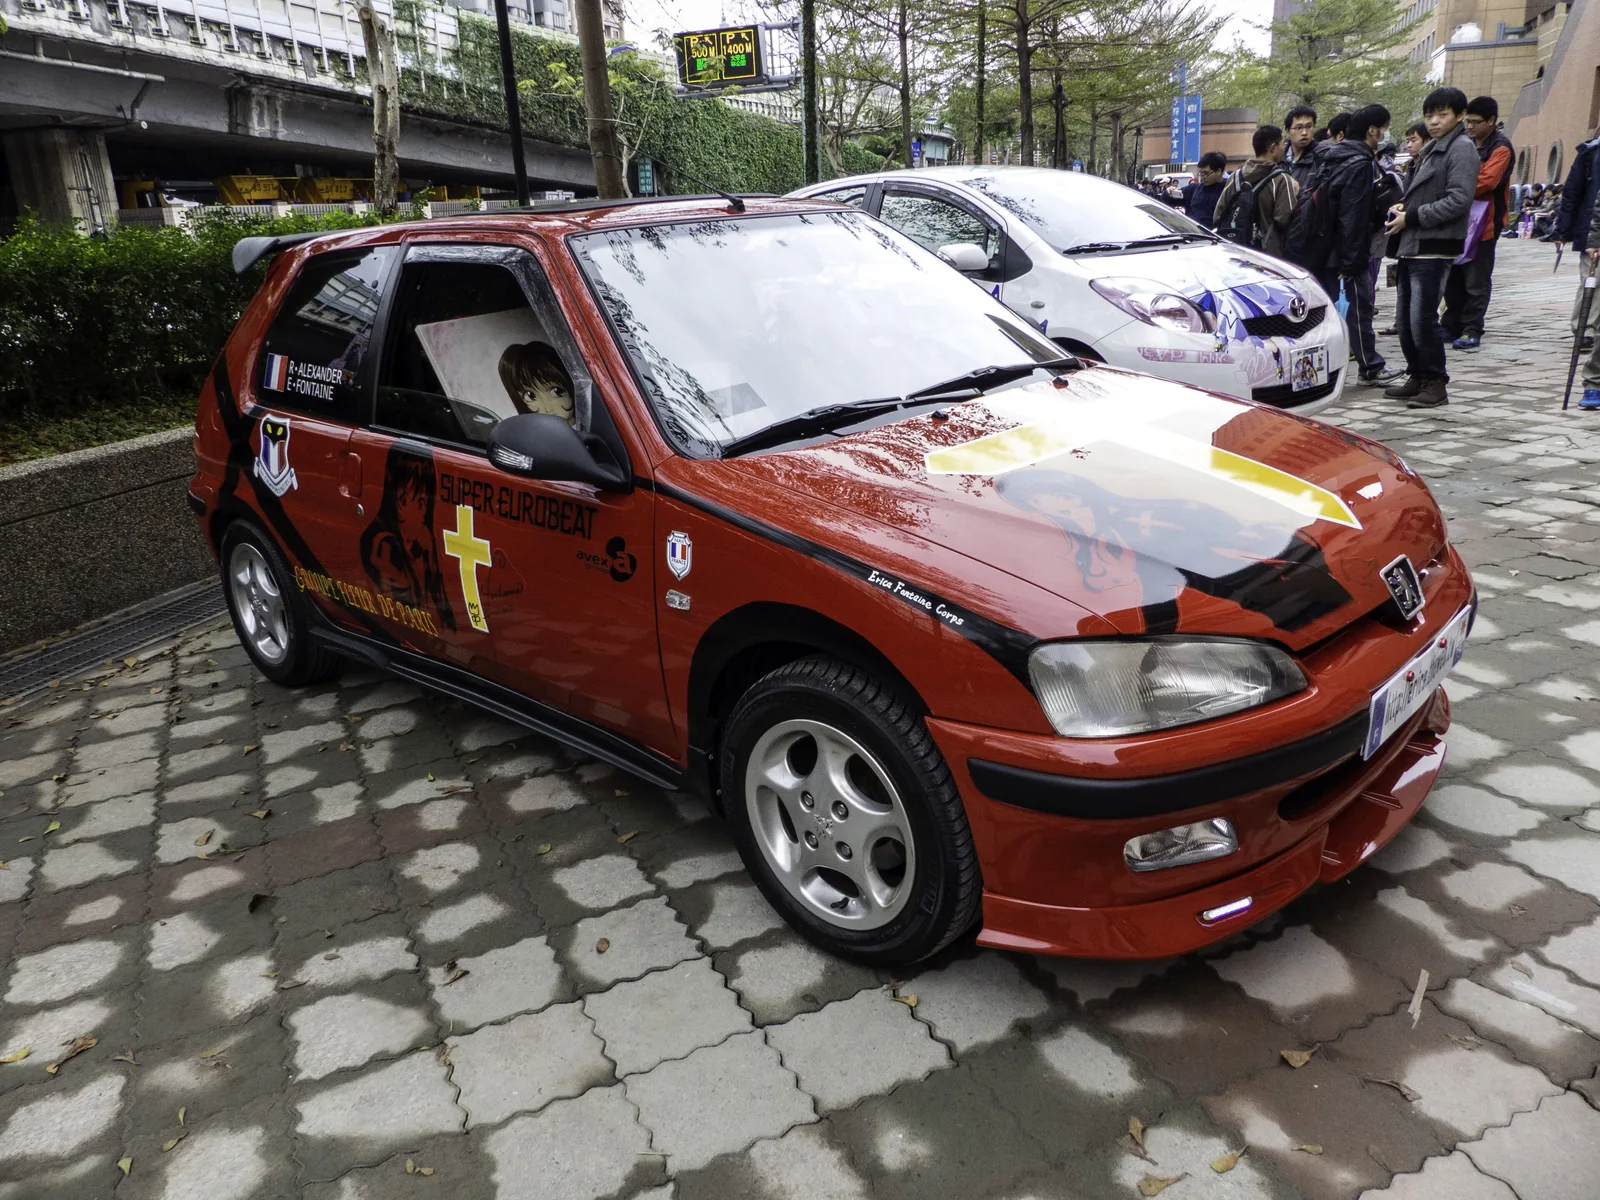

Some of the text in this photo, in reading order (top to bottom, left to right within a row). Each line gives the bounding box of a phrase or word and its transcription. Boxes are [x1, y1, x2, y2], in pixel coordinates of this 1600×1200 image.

[726, 33, 736, 44] P
[692, 46, 715, 58] 500 M
[723, 42, 752, 55] 1400 M
[440, 473, 598, 541] SUPER EUROBEAT
[576, 550, 609, 568] avex
[867, 570, 892, 589] Erica
[935, 604, 964, 626] Corps
[376, 593, 399, 622] DE
[396, 601, 439, 638] PARIS
[1372, 728, 1380, 744] F
